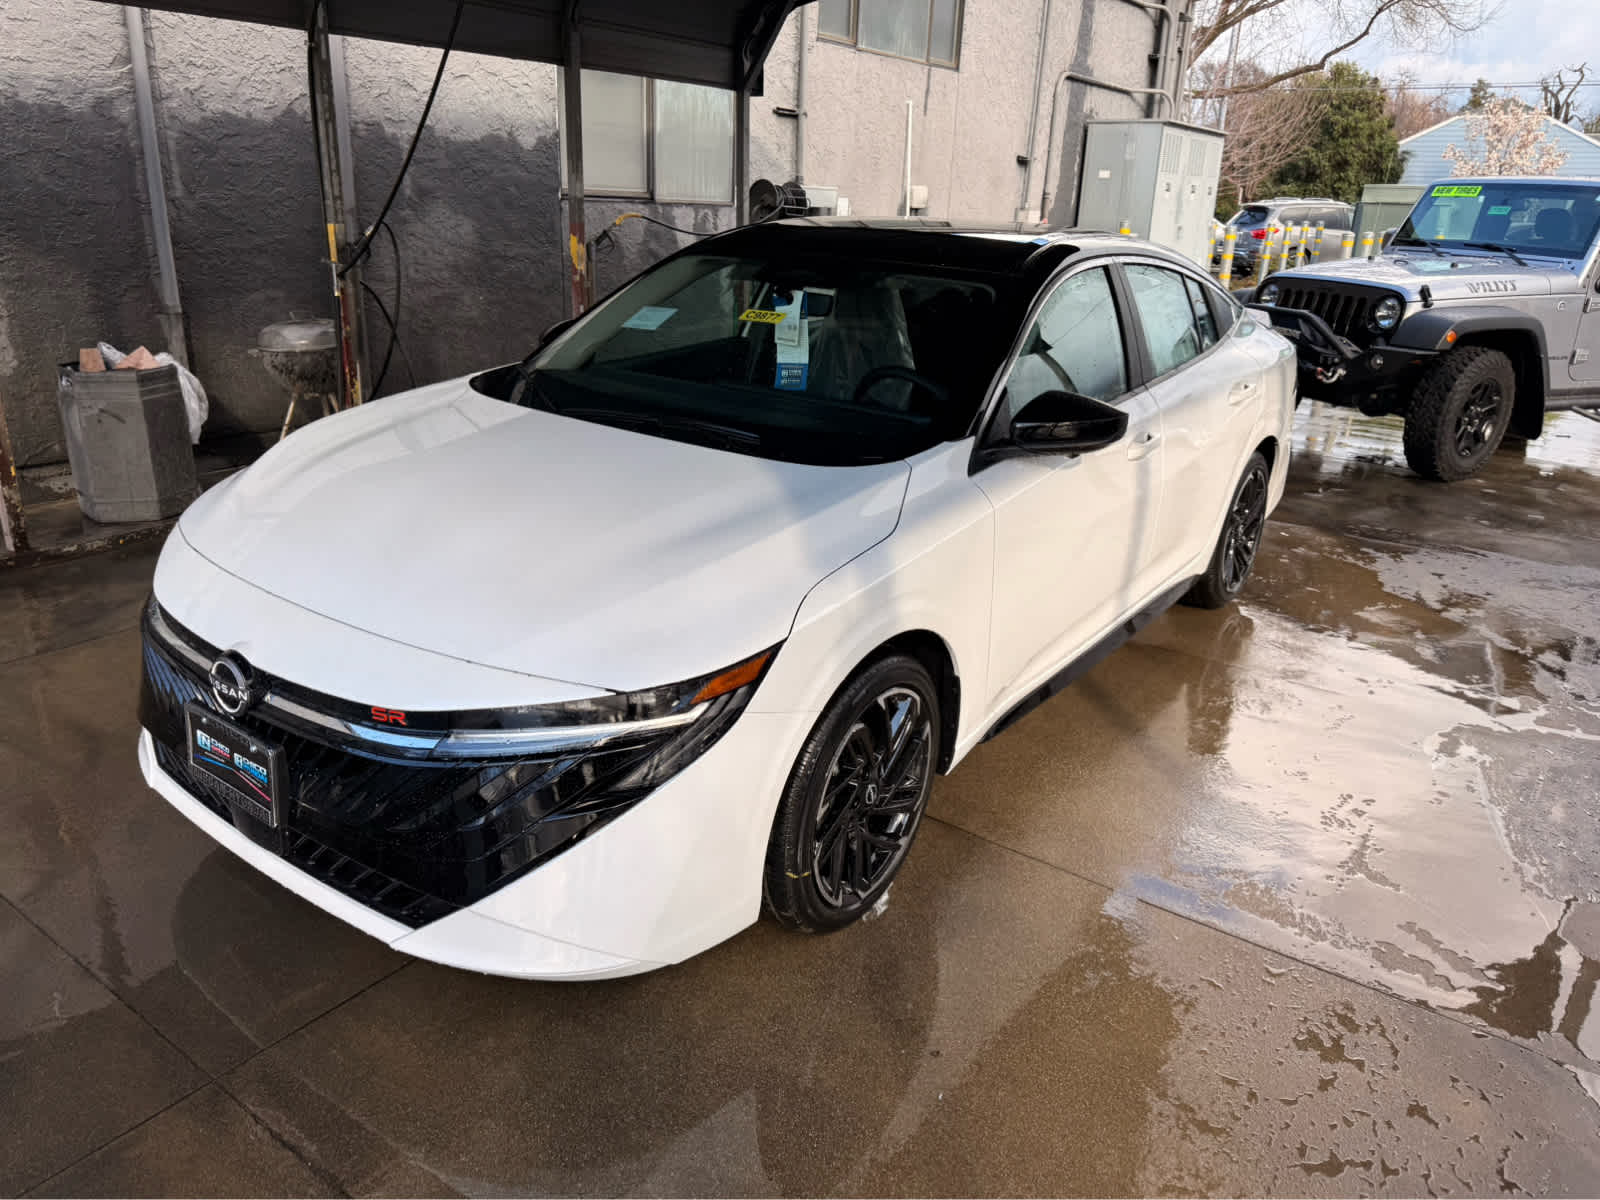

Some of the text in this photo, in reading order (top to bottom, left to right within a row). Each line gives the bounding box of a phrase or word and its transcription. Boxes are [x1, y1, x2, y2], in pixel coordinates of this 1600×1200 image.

[1434, 186, 1481, 195] NEW TIRES
[1464, 280, 1517, 293] WILLYS
[209, 674, 248, 701] ISSAN
[371, 706, 407, 726] SR
